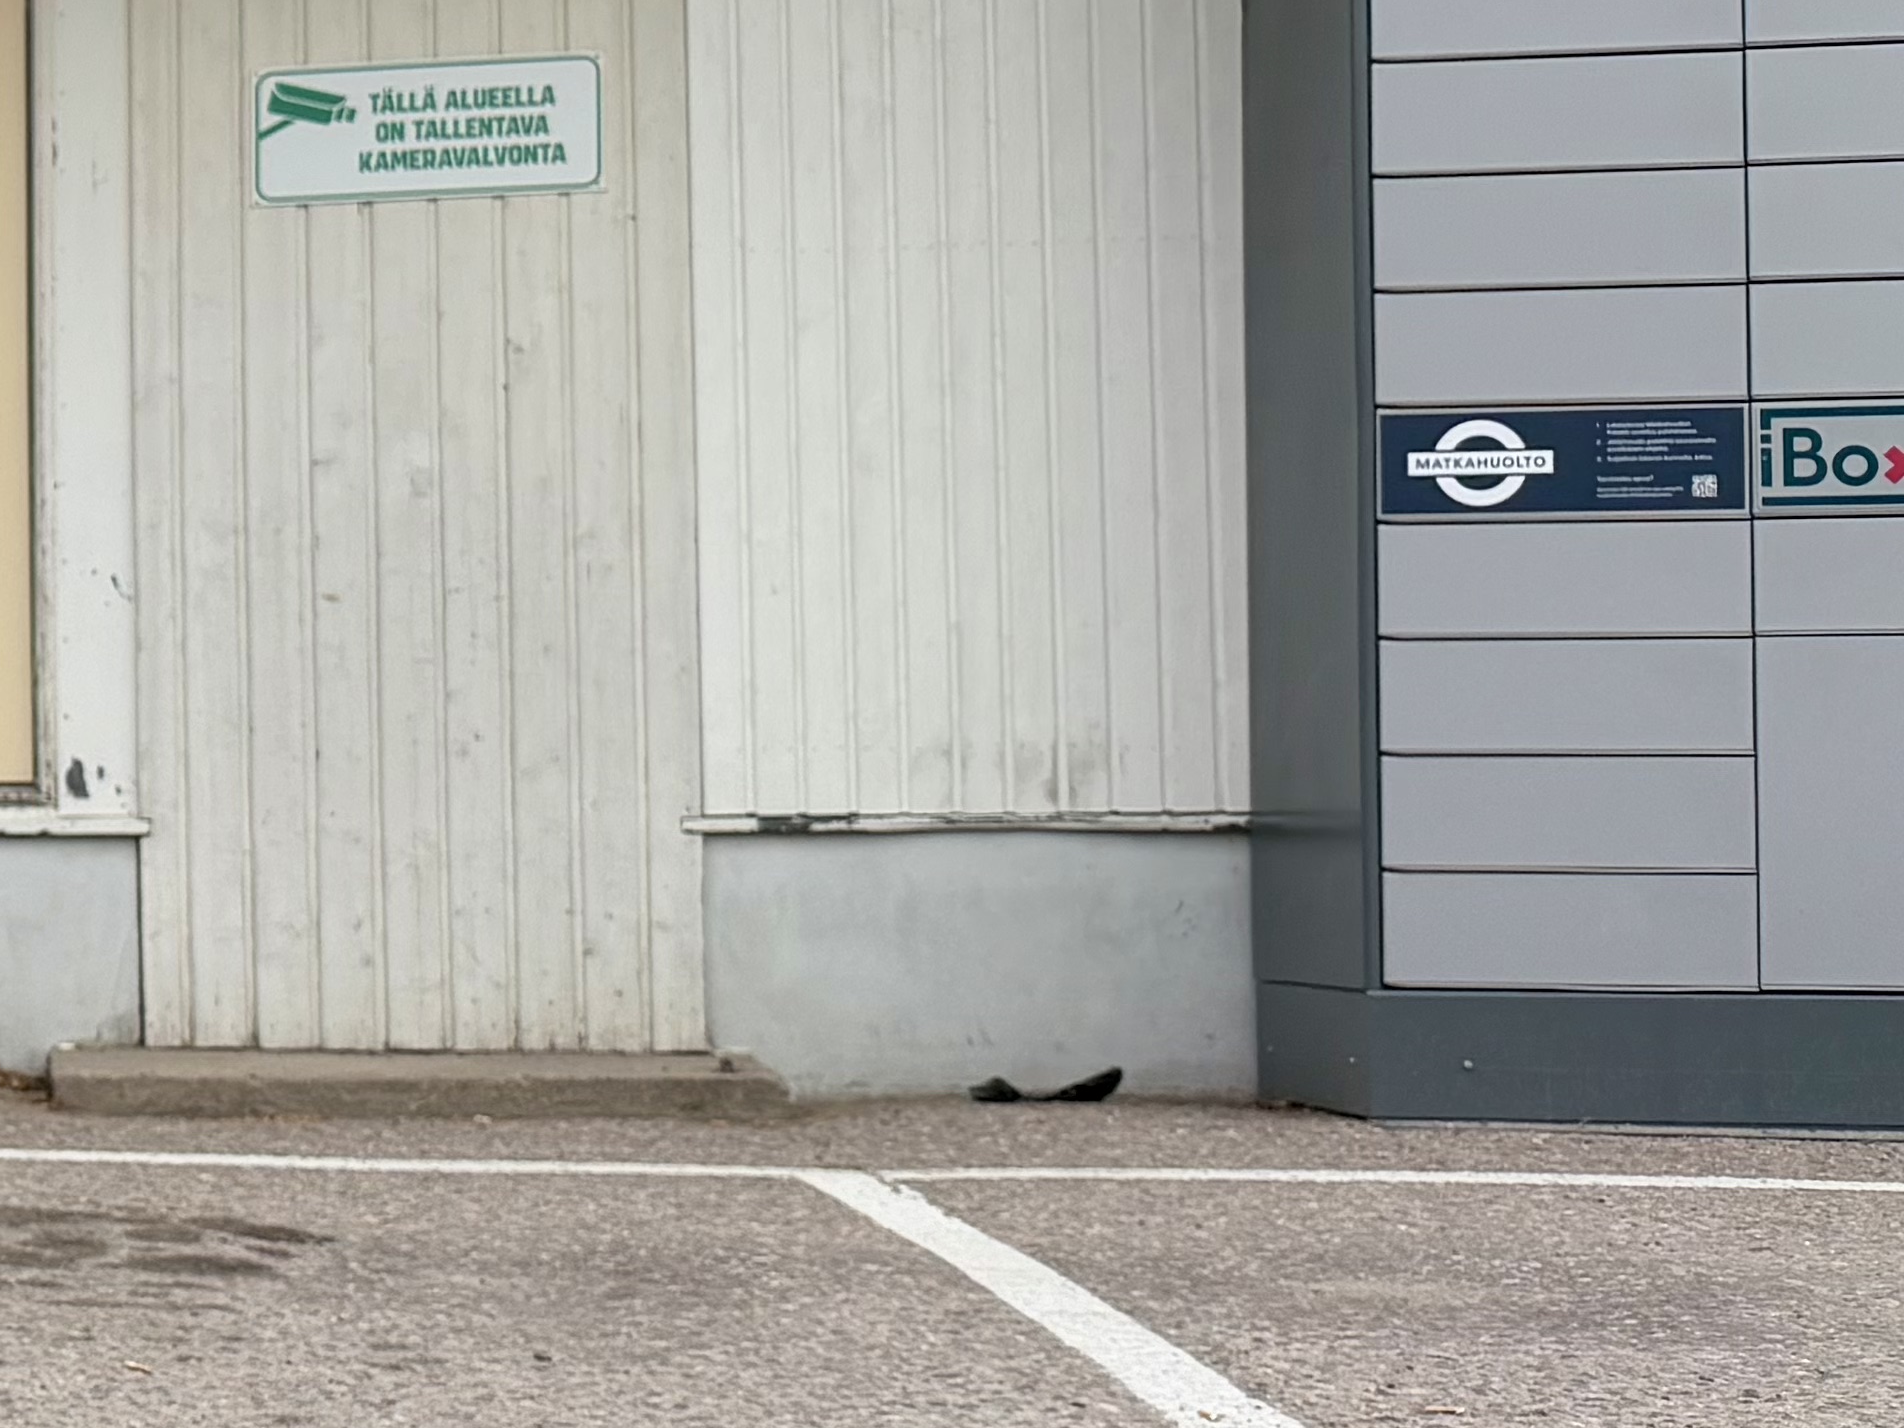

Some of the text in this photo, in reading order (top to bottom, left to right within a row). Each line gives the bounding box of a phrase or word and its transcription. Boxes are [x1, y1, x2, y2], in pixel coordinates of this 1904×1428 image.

[369, 84, 556, 114] TÄLLÄ ALUEELLA
[375, 114, 550, 143] ON TALLENTAVA
[358, 142, 568, 174] KAMERAVALVONTA
[1415, 455, 1546, 471] MATKAHUOLTO
